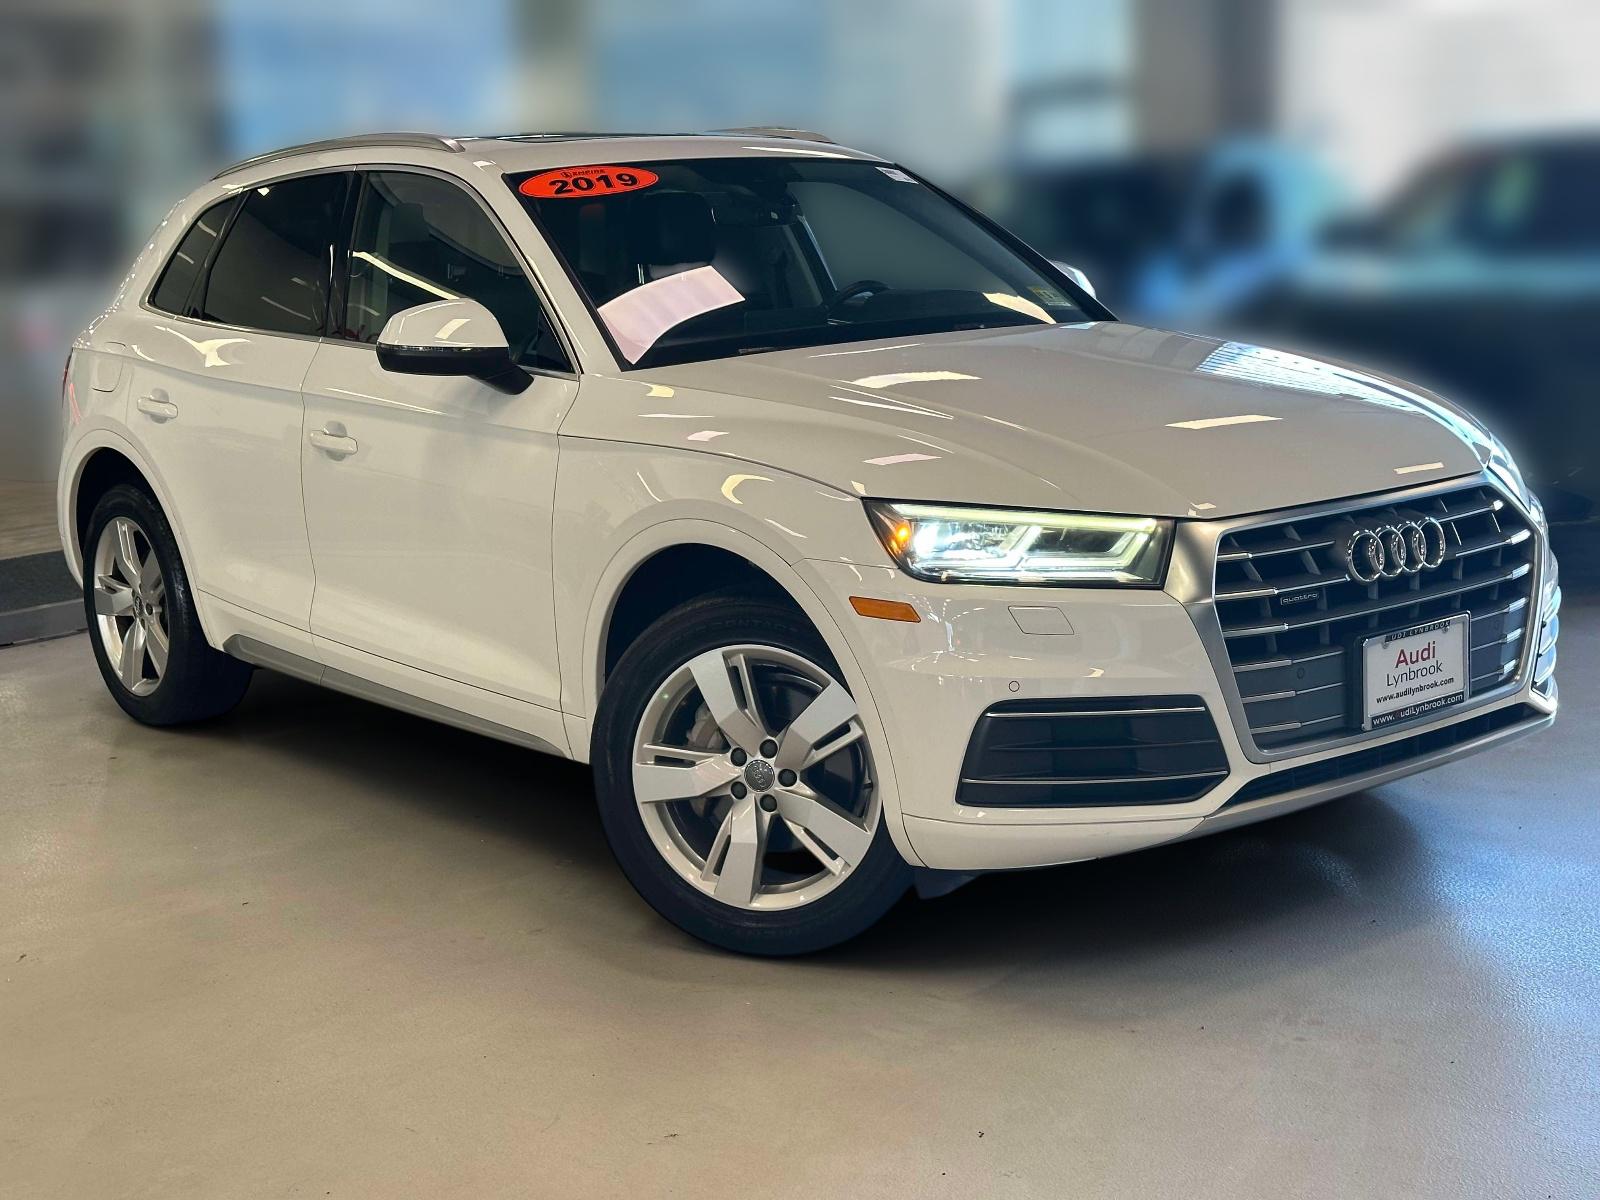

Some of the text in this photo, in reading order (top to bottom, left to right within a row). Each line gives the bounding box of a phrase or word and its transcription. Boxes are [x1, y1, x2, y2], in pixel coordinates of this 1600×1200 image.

[549, 173, 638, 194] 2019
[1283, 593, 1318, 604] quattro
[1409, 621, 1450, 636] LYNBROOK
[1395, 640, 1436, 669] Audi
[1386, 660, 1443, 688] Lynbrook
[1376, 676, 1455, 703] www.audilynbrook.com
[1372, 693, 1463, 725] www.udiLynbrook.com
